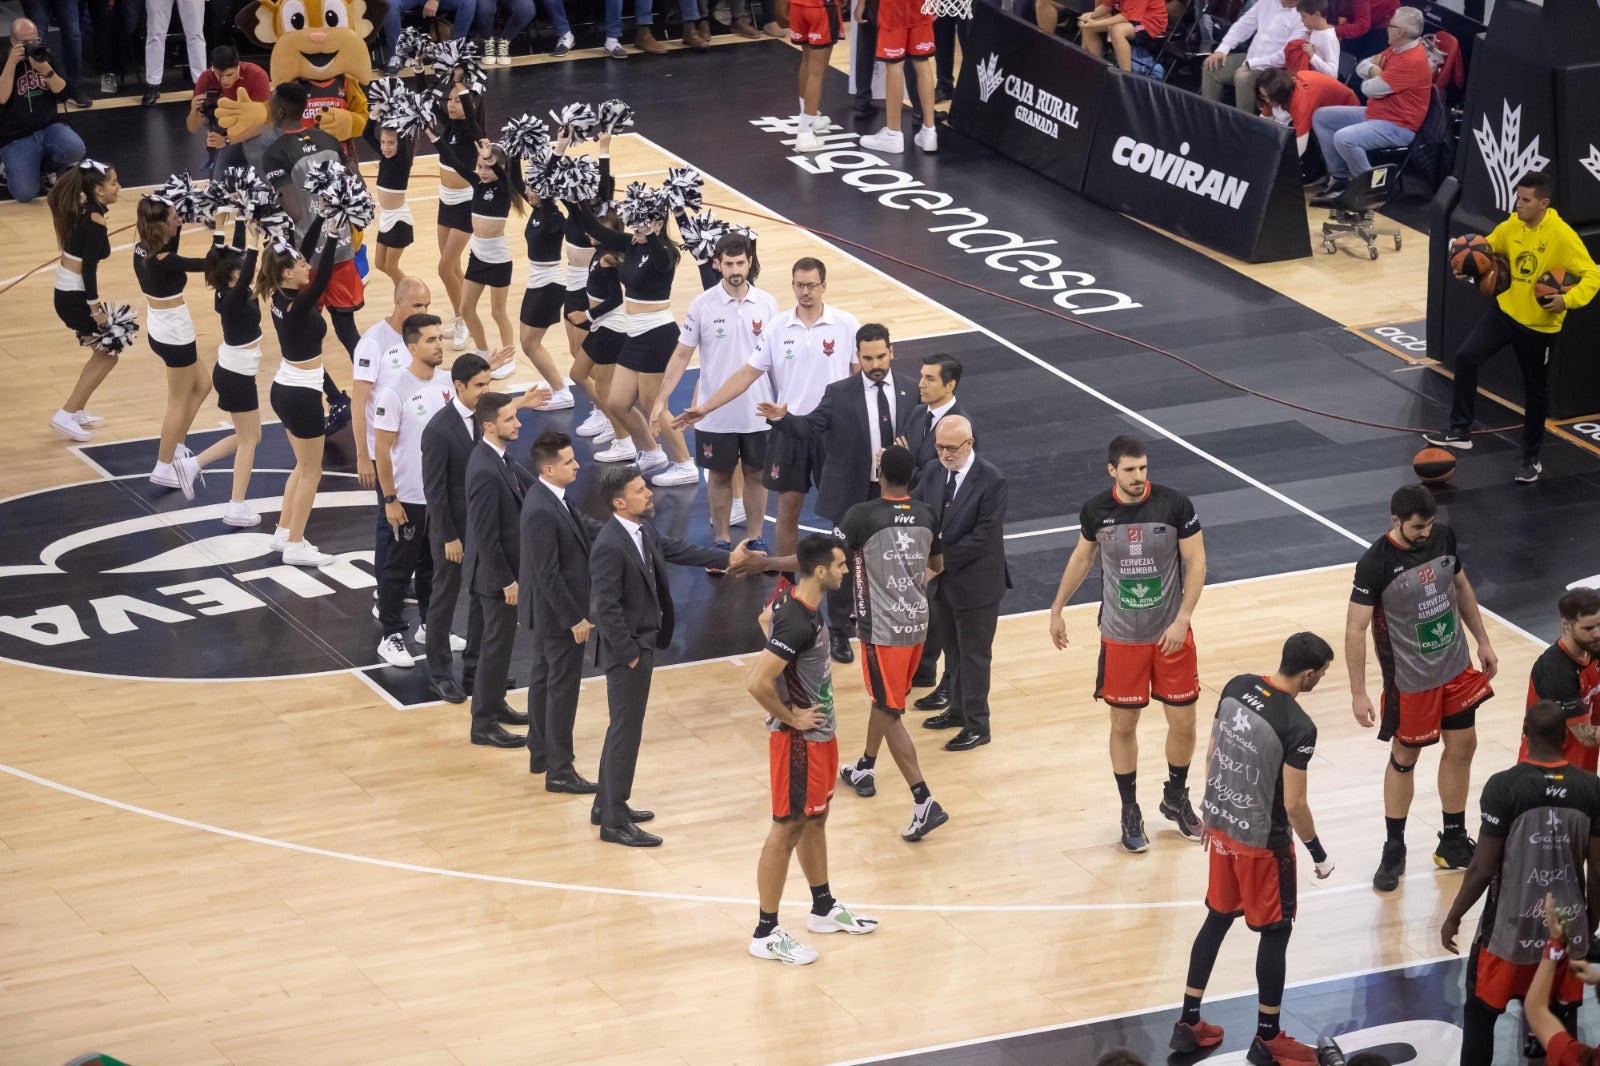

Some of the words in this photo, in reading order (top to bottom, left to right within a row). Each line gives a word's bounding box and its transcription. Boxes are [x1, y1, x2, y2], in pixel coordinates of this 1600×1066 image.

[1004, 74, 1034, 107] CAJA
[1035, 88, 1079, 129] RURAL
[1015, 105, 1058, 139] GRANADA
[1374, 326, 1427, 351] acb
[894, 513, 915, 524] vive
[1120, 557, 1155, 567] CERVEZAS
[1120, 565, 1158, 575] ALHAMBRA
[0, 551, 378, 646] ULEVA
[1418, 592, 1447, 611] CERVEZAS
[1418, 600, 1451, 619] ALHAMBRA
[1242, 692, 1265, 711] vive
[1219, 720, 1259, 754] Granada
[1203, 799, 1250, 830] VOLVO
[1518, 935, 1583, 949] VOO
